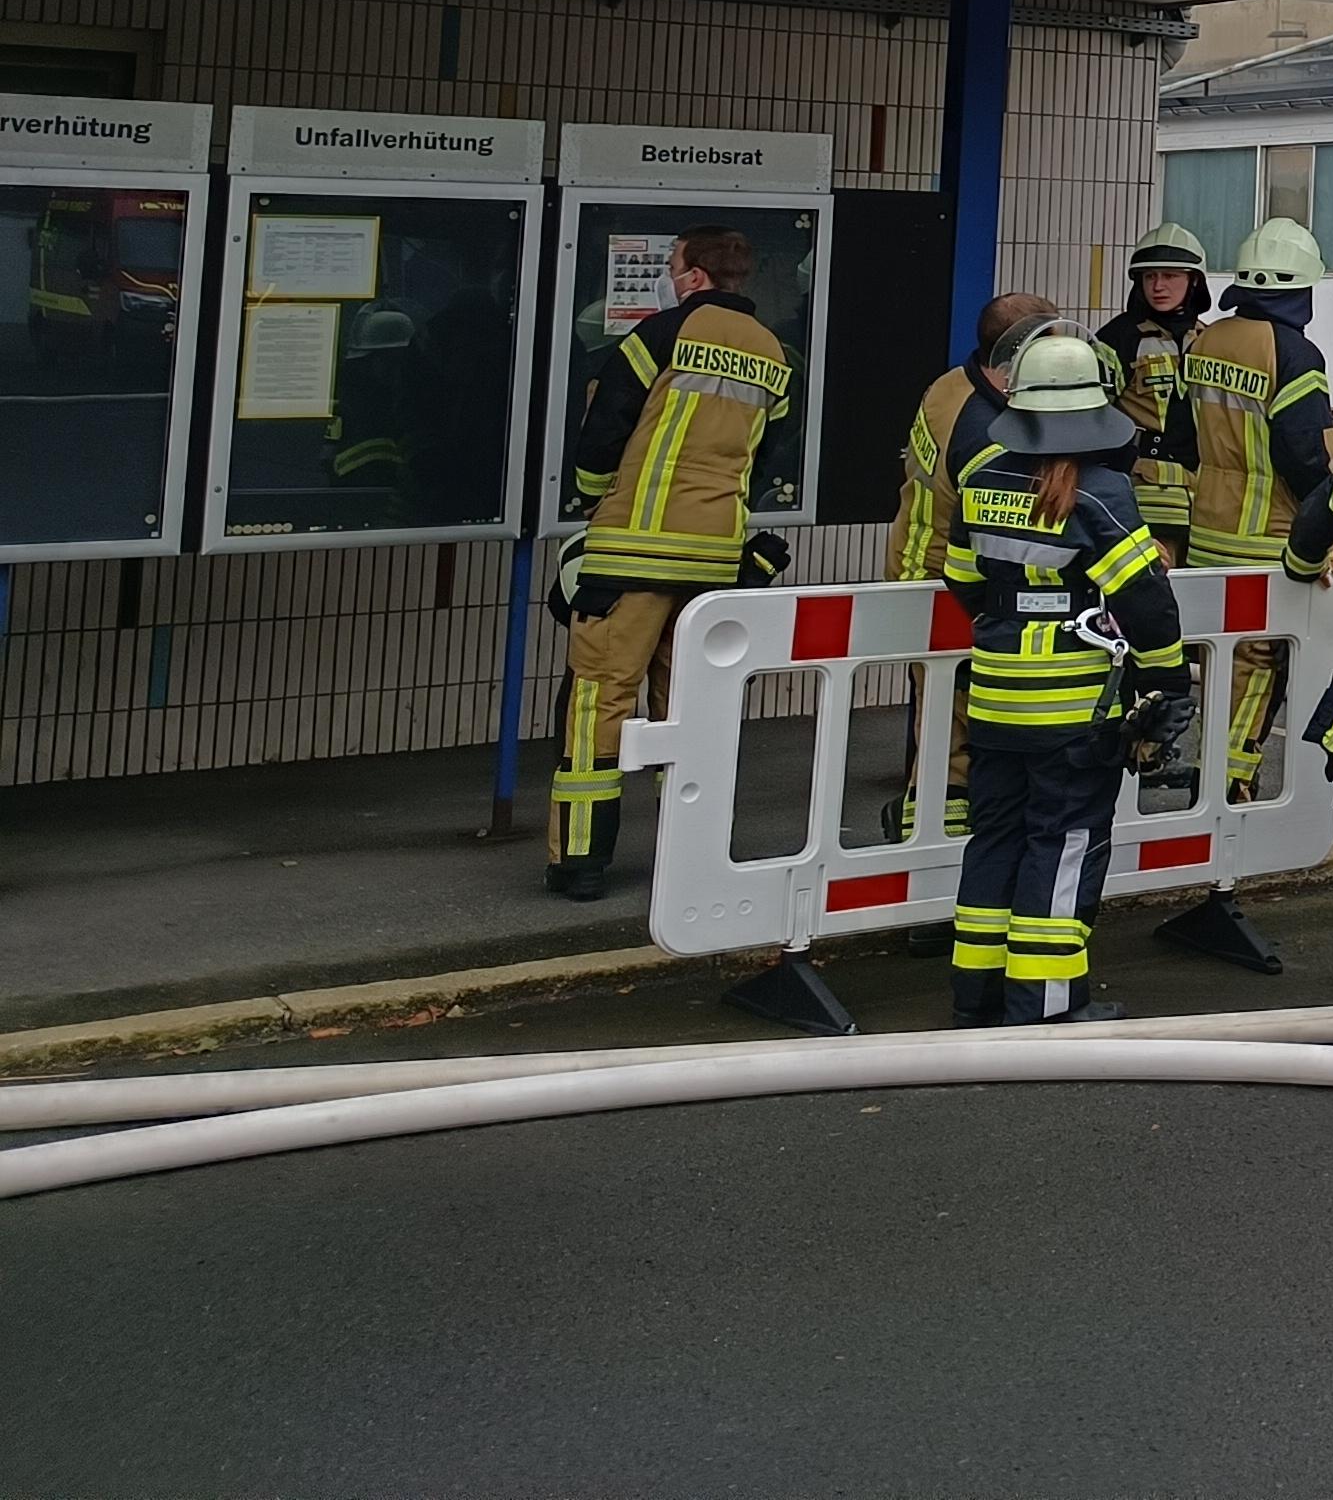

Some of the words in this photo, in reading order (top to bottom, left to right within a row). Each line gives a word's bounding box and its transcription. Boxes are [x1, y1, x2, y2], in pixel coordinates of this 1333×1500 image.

[0, 115, 153, 144] rverhütung
[295, 126, 494, 156] Unfallverhütung
[641, 144, 763, 165] Betriebsrat
[676, 342, 787, 392] WEISSENSTADT
[973, 489, 1032, 509] FEUERWE
